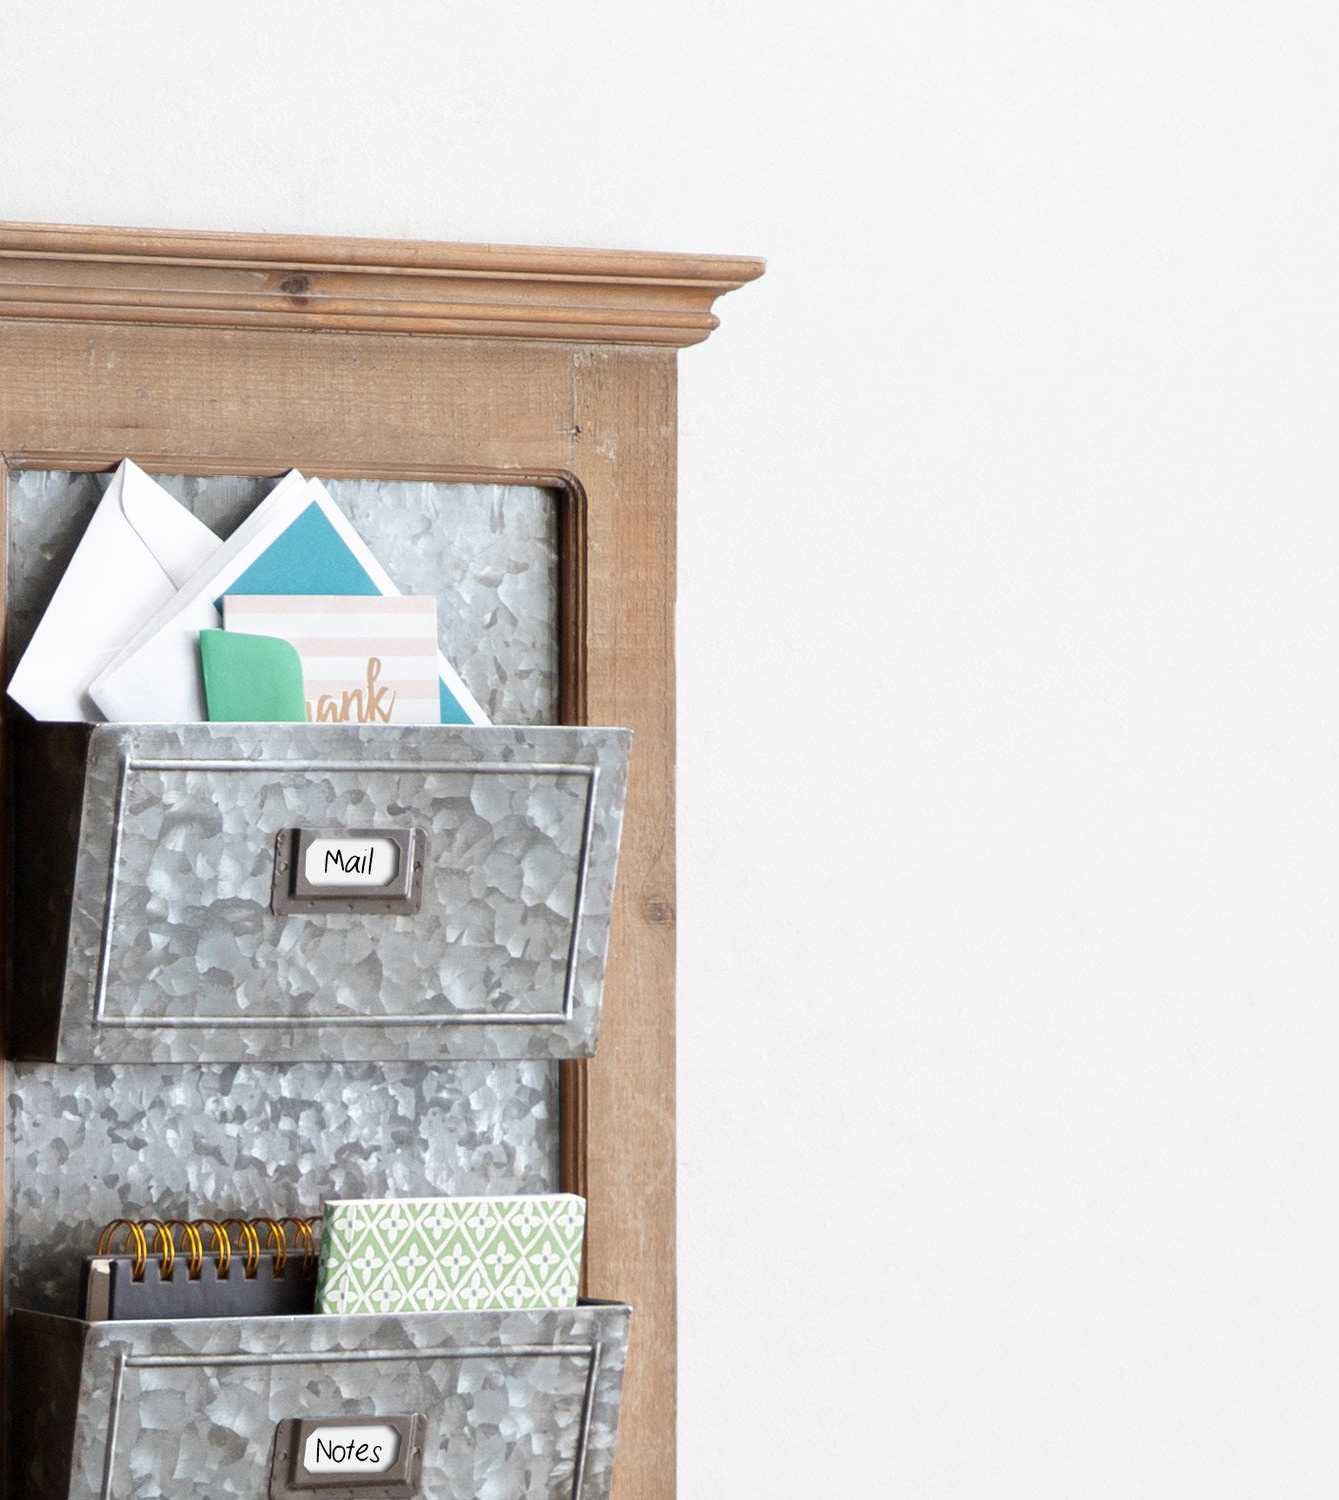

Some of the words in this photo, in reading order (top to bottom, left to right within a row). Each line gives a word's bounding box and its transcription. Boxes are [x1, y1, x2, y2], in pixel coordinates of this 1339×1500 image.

[305, 656, 397, 723] ank
[324, 847, 374, 875] Mail
[316, 1438, 383, 1464] Notes
